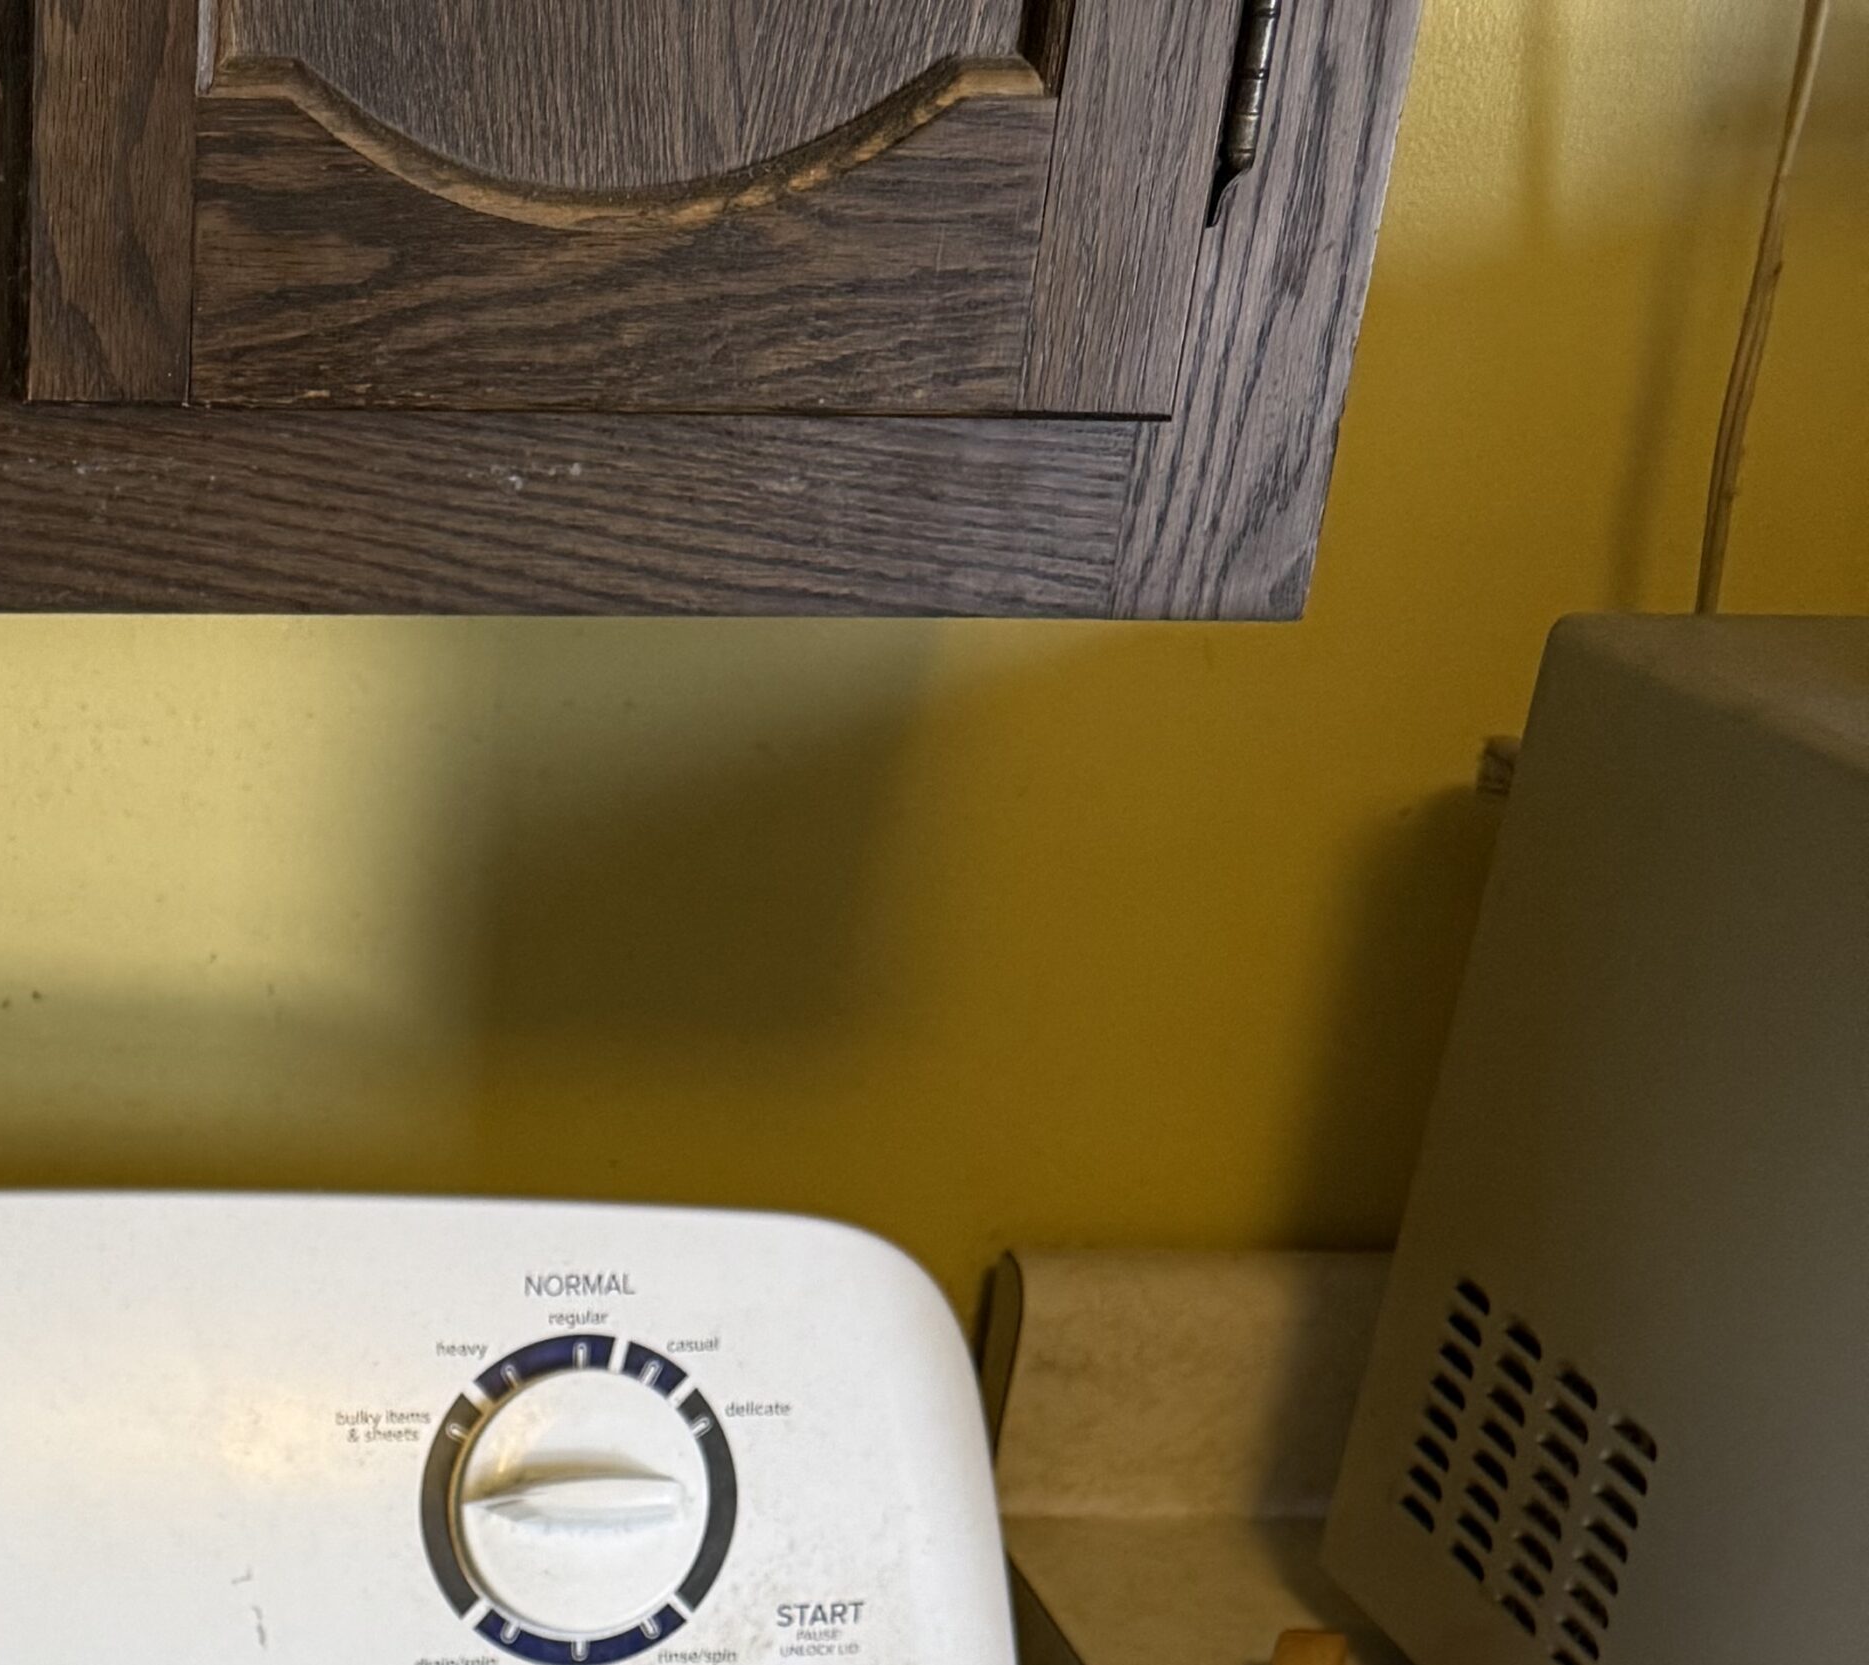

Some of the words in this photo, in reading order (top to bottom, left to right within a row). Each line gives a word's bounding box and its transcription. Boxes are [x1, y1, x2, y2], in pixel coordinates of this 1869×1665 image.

[524, 1273, 636, 1297] NORMAL
[548, 1311, 608, 1329] regular
[436, 1342, 488, 1359] heavy
[666, 1337, 720, 1352] casual
[725, 1402, 792, 1418] delicate
[335, 1410, 382, 1428] bulky
[385, 1410, 430, 1424] items
[347, 1429, 359, 1442] &
[365, 1427, 420, 1442] sheets
[777, 1601, 865, 1627] START
[779, 1645, 836, 1657] UNLOCK
